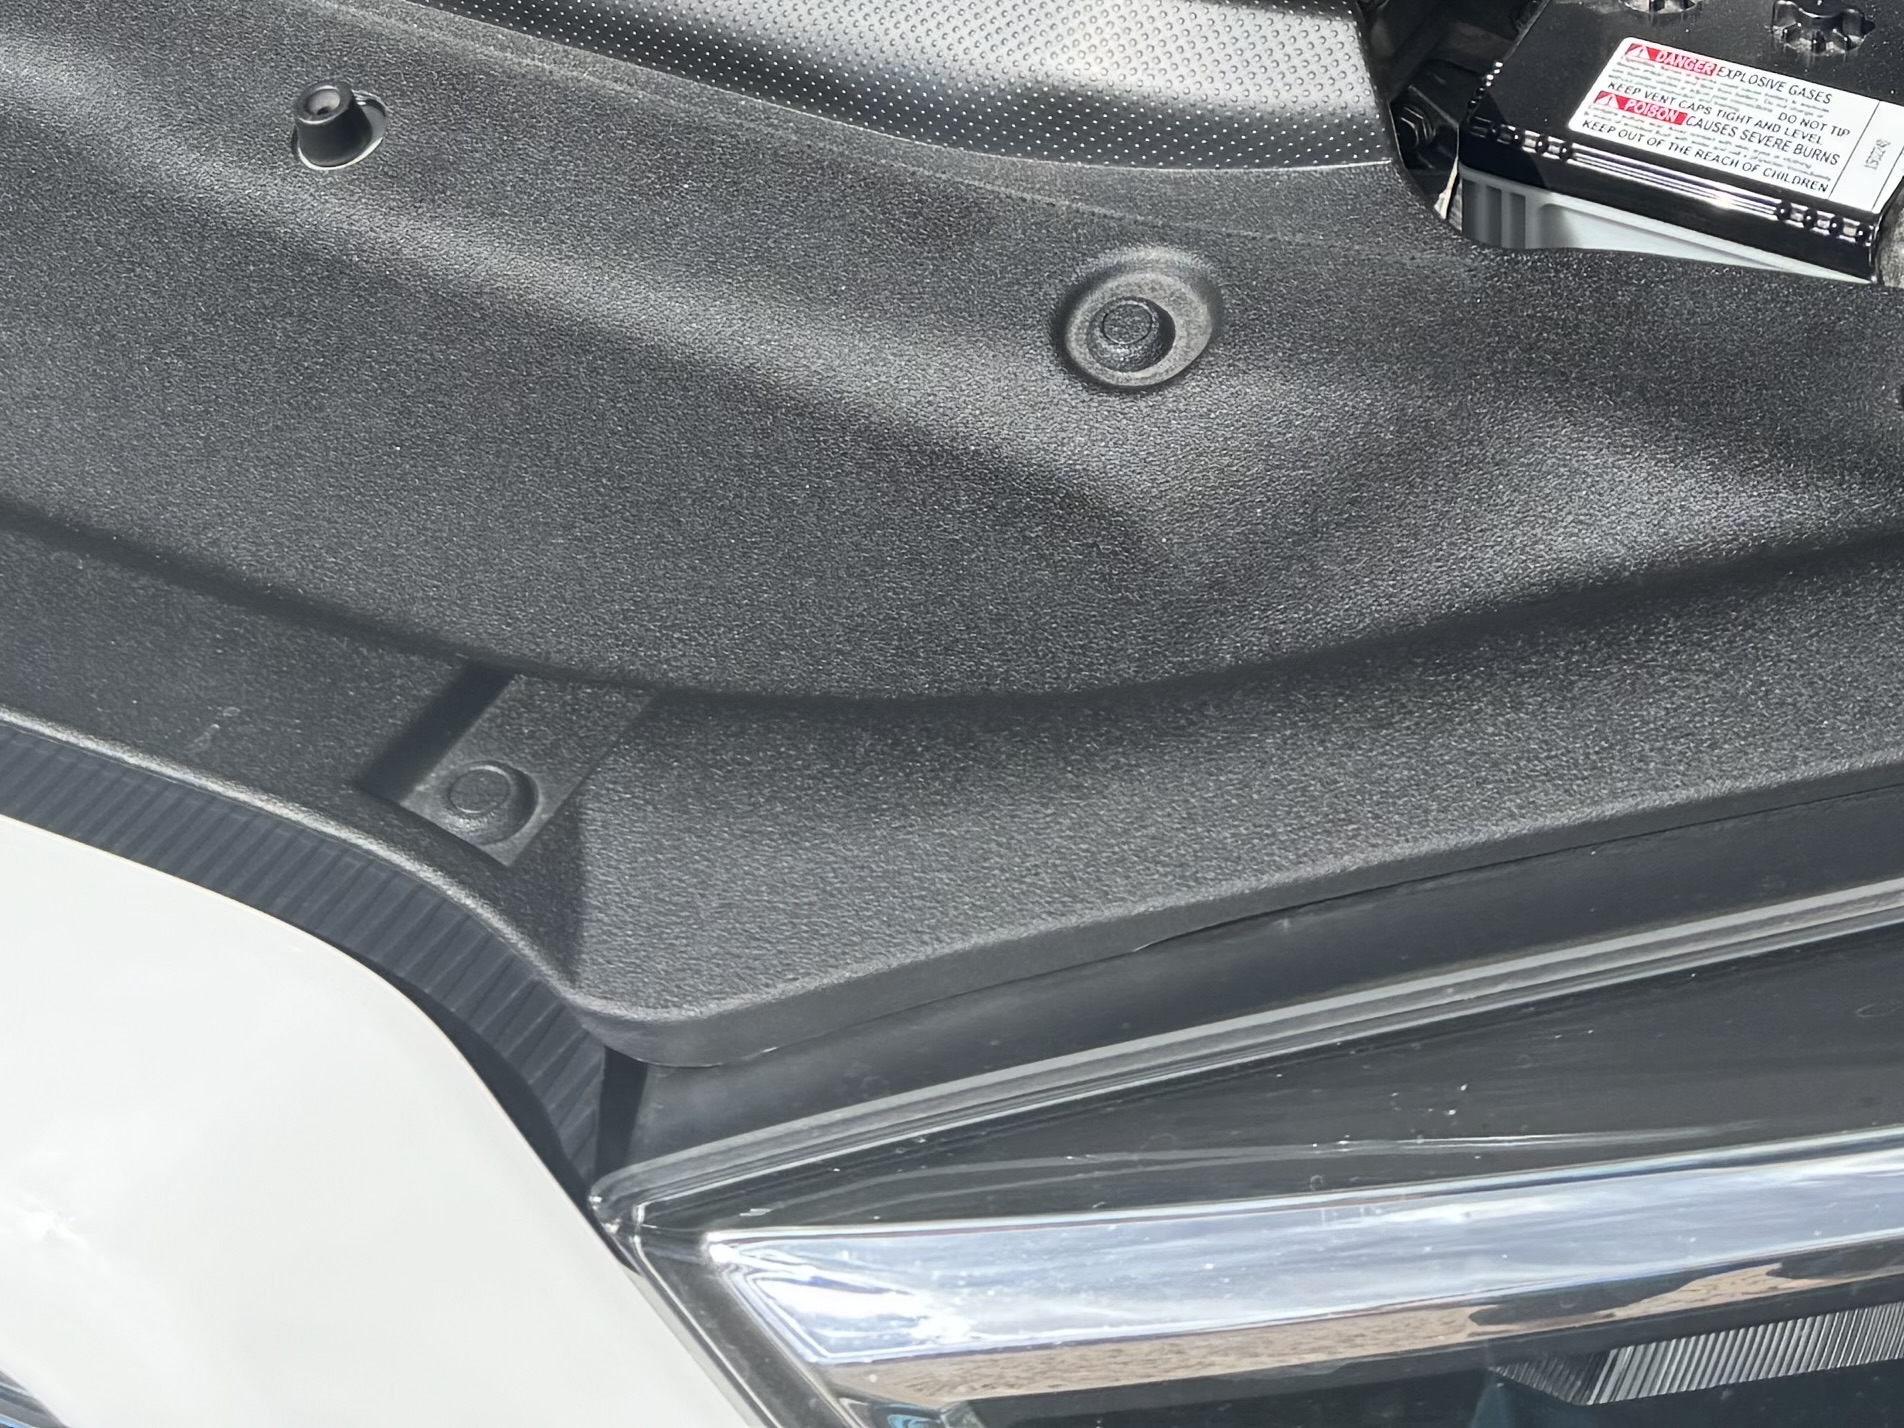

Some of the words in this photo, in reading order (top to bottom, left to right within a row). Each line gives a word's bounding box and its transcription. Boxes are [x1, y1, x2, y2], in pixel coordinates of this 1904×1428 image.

[1655, 50, 1716, 76] DANGER
[1716, 66, 1787, 93] EXPLOSIVE
[1788, 84, 1833, 104] GASES
[1607, 81, 1642, 95] KEEP
[1644, 90, 1677, 105] VENT
[1678, 99, 1713, 116] CAPS
[1716, 108, 1753, 125] TIGHT
[1754, 119, 1782, 133] AND
[1784, 126, 1824, 145] LEVEL
[1624, 99, 1679, 123] POISON
[1685, 115, 1738, 138] CAUSES
[1739, 130, 1793, 153] SEVERE
[1793, 145, 1841, 166] BURNS
[1778, 112, 1797, 124] DO
[1798, 117, 1828, 131] NOT
[1831, 124, 1851, 138] TIP
[1582, 119, 1616, 134] KEEP
[1618, 129, 1645, 143] OUT
[1646, 136, 1665, 148] OF
[1668, 141, 1692, 156] THE
[1695, 148, 1739, 169] REACH
[1742, 160, 1761, 174] OF
[1762, 167, 1829, 194] CHILDREN
